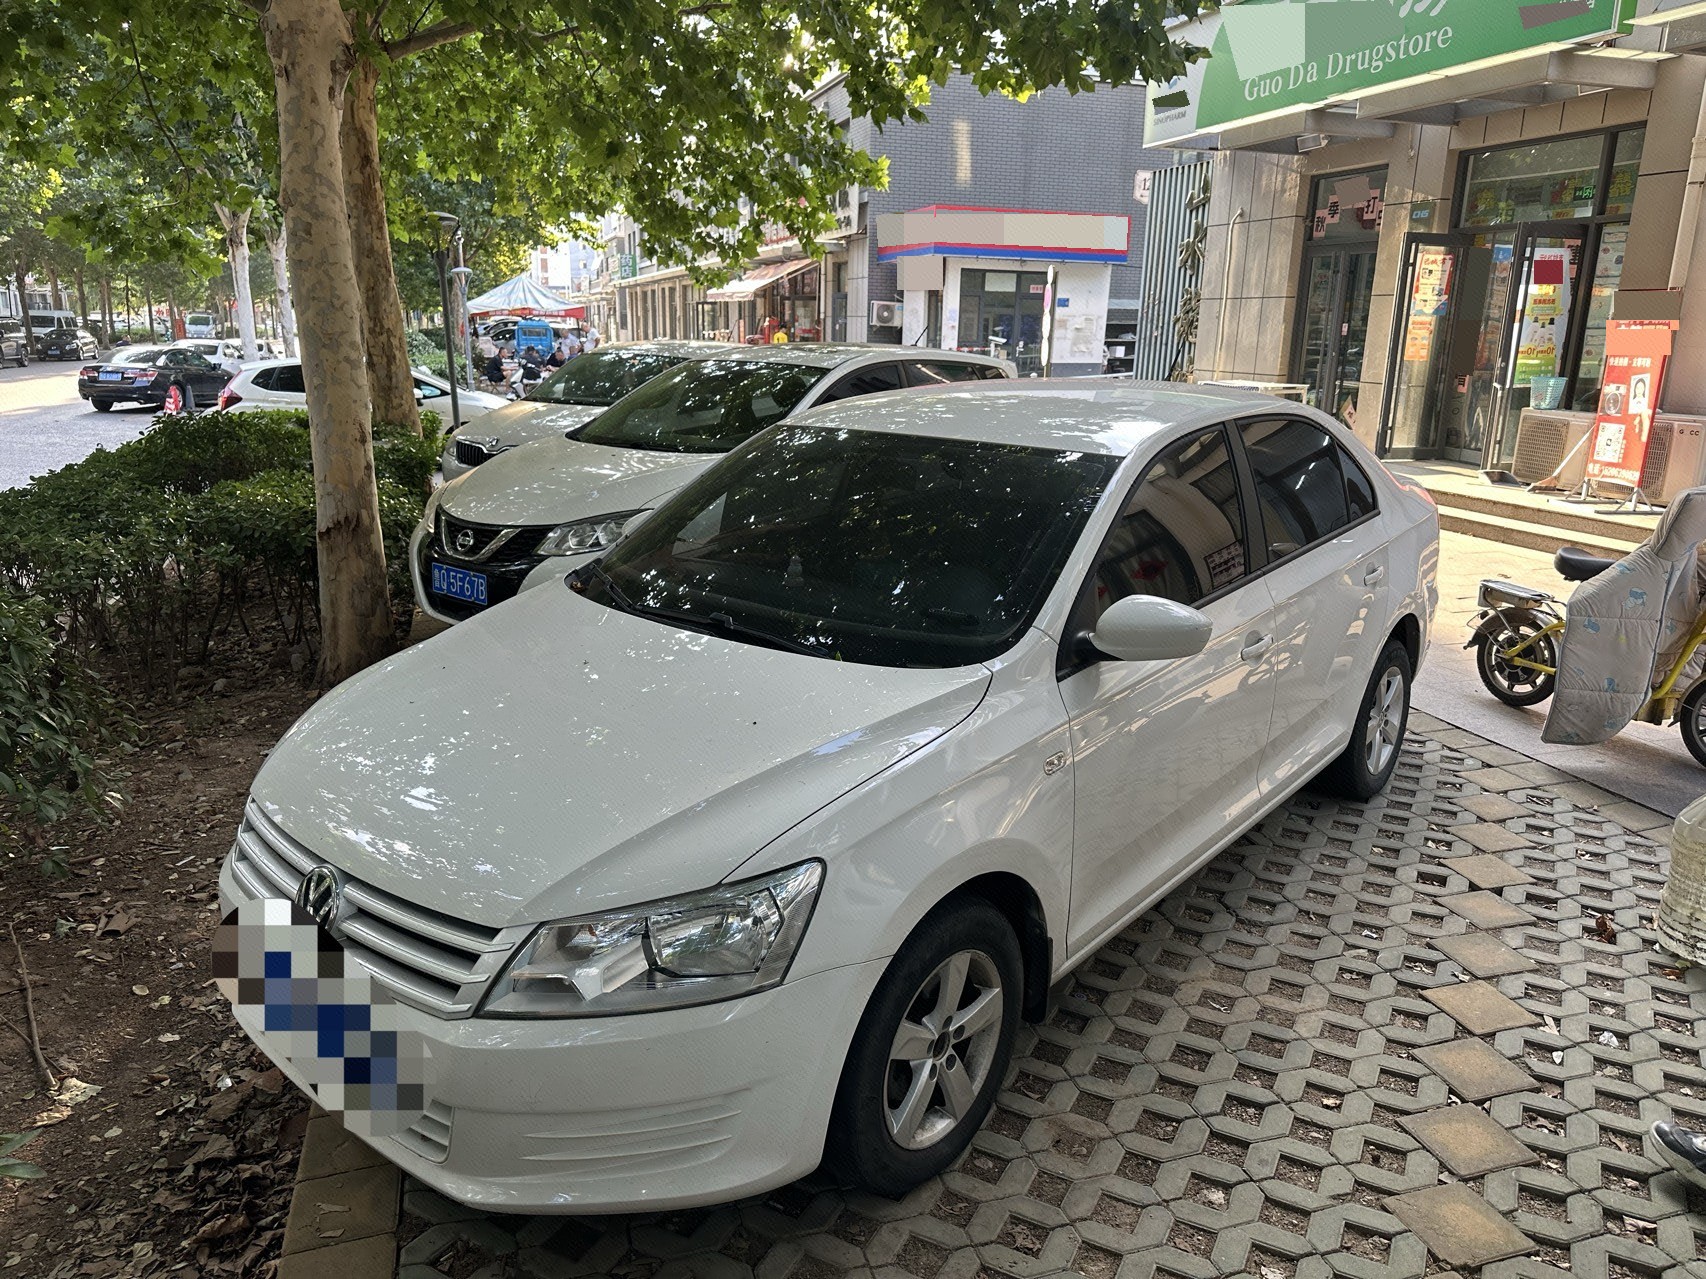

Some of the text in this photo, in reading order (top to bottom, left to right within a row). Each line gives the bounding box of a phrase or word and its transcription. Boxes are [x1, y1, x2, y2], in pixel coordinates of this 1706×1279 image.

[1244, 25, 1453, 101] Guo Da Drugstore
